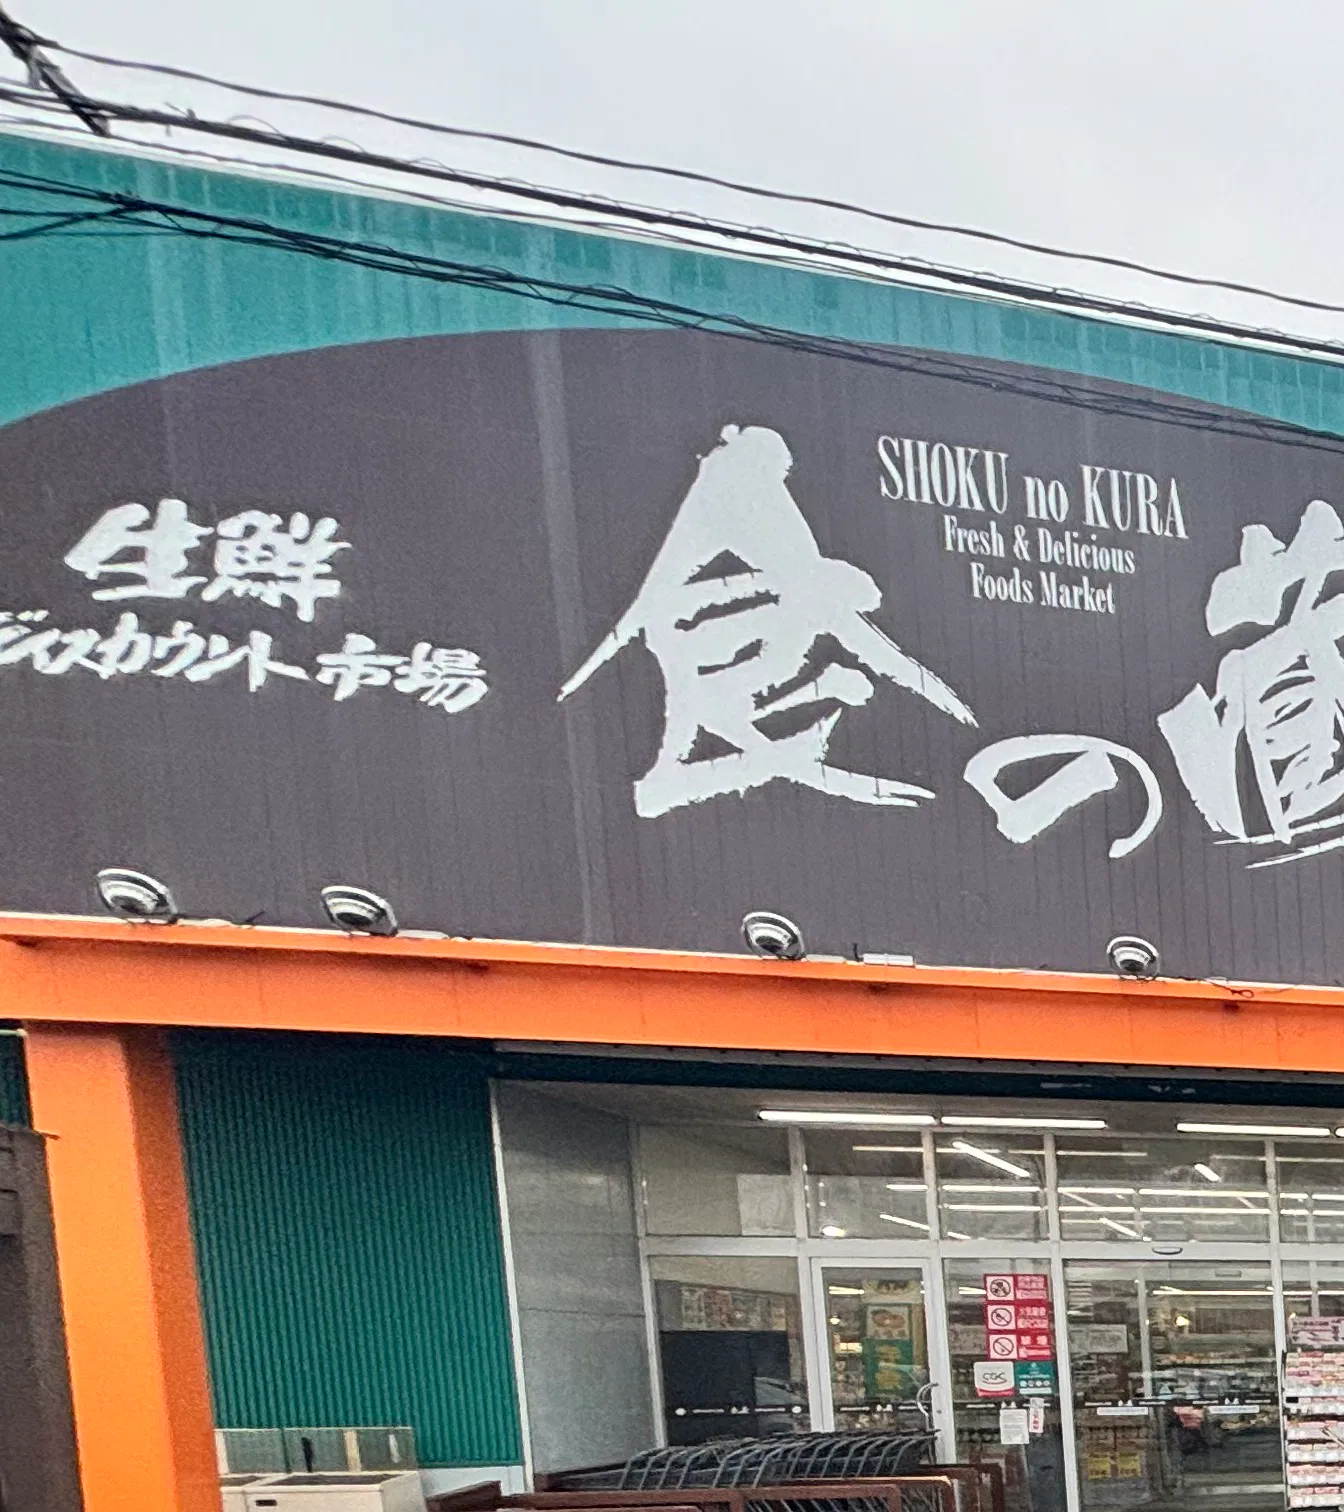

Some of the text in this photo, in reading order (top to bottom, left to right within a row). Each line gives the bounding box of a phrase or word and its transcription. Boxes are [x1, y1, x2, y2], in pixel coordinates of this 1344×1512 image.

[877, 434, 1190, 541] SHOKU no KURA
[64, 498, 353, 622] 生鮮
[943, 514, 1136, 575] Fresh & Delicious
[969, 562, 1116, 614] Foods Market
